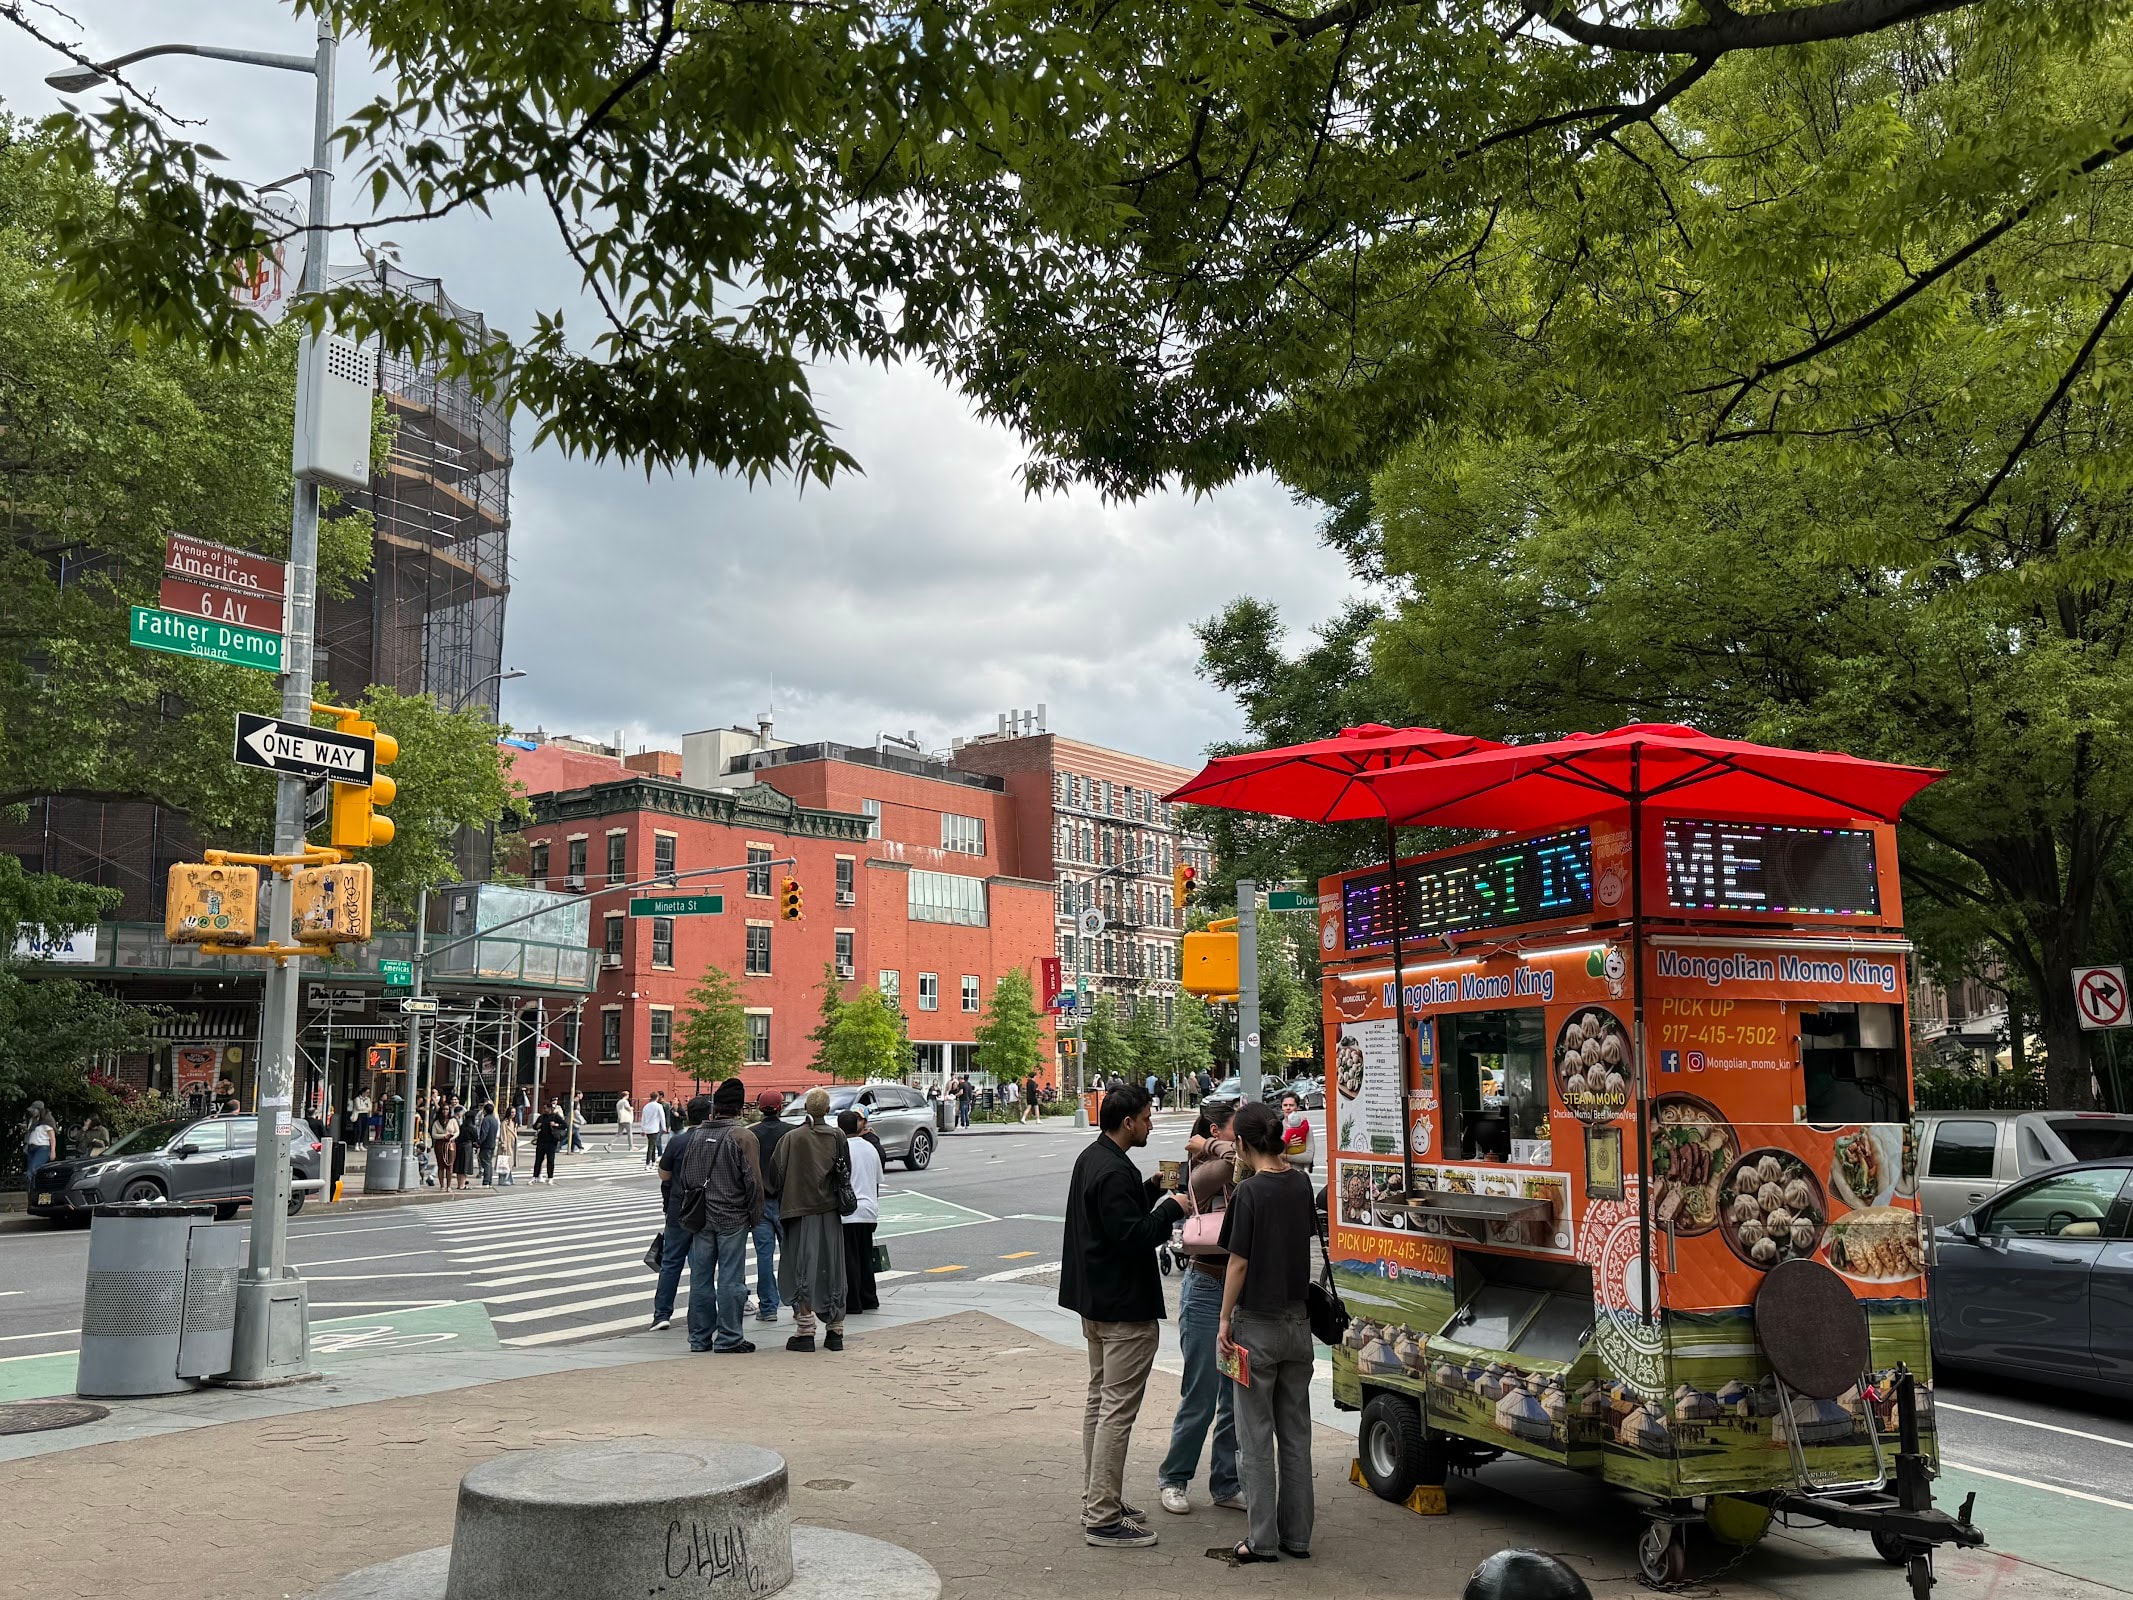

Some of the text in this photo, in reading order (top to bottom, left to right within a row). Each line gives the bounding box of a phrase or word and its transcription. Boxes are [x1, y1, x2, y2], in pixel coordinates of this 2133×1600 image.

[173, 541, 239, 567] Avenue of the
[204, 540, 224, 551] VILLAGE
[224, 544, 246, 557] HISTORIC
[246, 551, 267, 562] DISTRICT
[172, 552, 258, 589] Americas
[199, 580, 220, 590] VILLAGE
[220, 585, 242, 596] HISTORIC
[243, 589, 265, 600] DISTRICT
[201, 592, 247, 624] 6 Av
[138, 612, 277, 656] Father Demo
[190, 642, 228, 659] Square
[263, 734, 356, 768] ONE WAY
[1664, 830, 1767, 900] ME
[1417, 855, 1525, 928] BEST
[654, 900, 698, 912] Minetta St
[29, 941, 74, 952] NOVA
[383, 964, 410, 973] Americas
[393, 973, 398, 984] 6
[1657, 950, 1896, 993] Mongolian Momo King
[1383, 966, 1555, 1012] Mngolian Momo King
[405, 1001, 417, 1009] ONE
[1662, 998, 1735, 1017] PICK UP
[1662, 1024, 1777, 1045] 917-415-7502
[1562, 1091, 1626, 1106] STEAM MOMO
[1553, 1109, 1574, 1119] Chicken
[1593, 1109, 1606, 1120] Beef
[1337, 1232, 1448, 1265] PICK UP 917-415-7502
